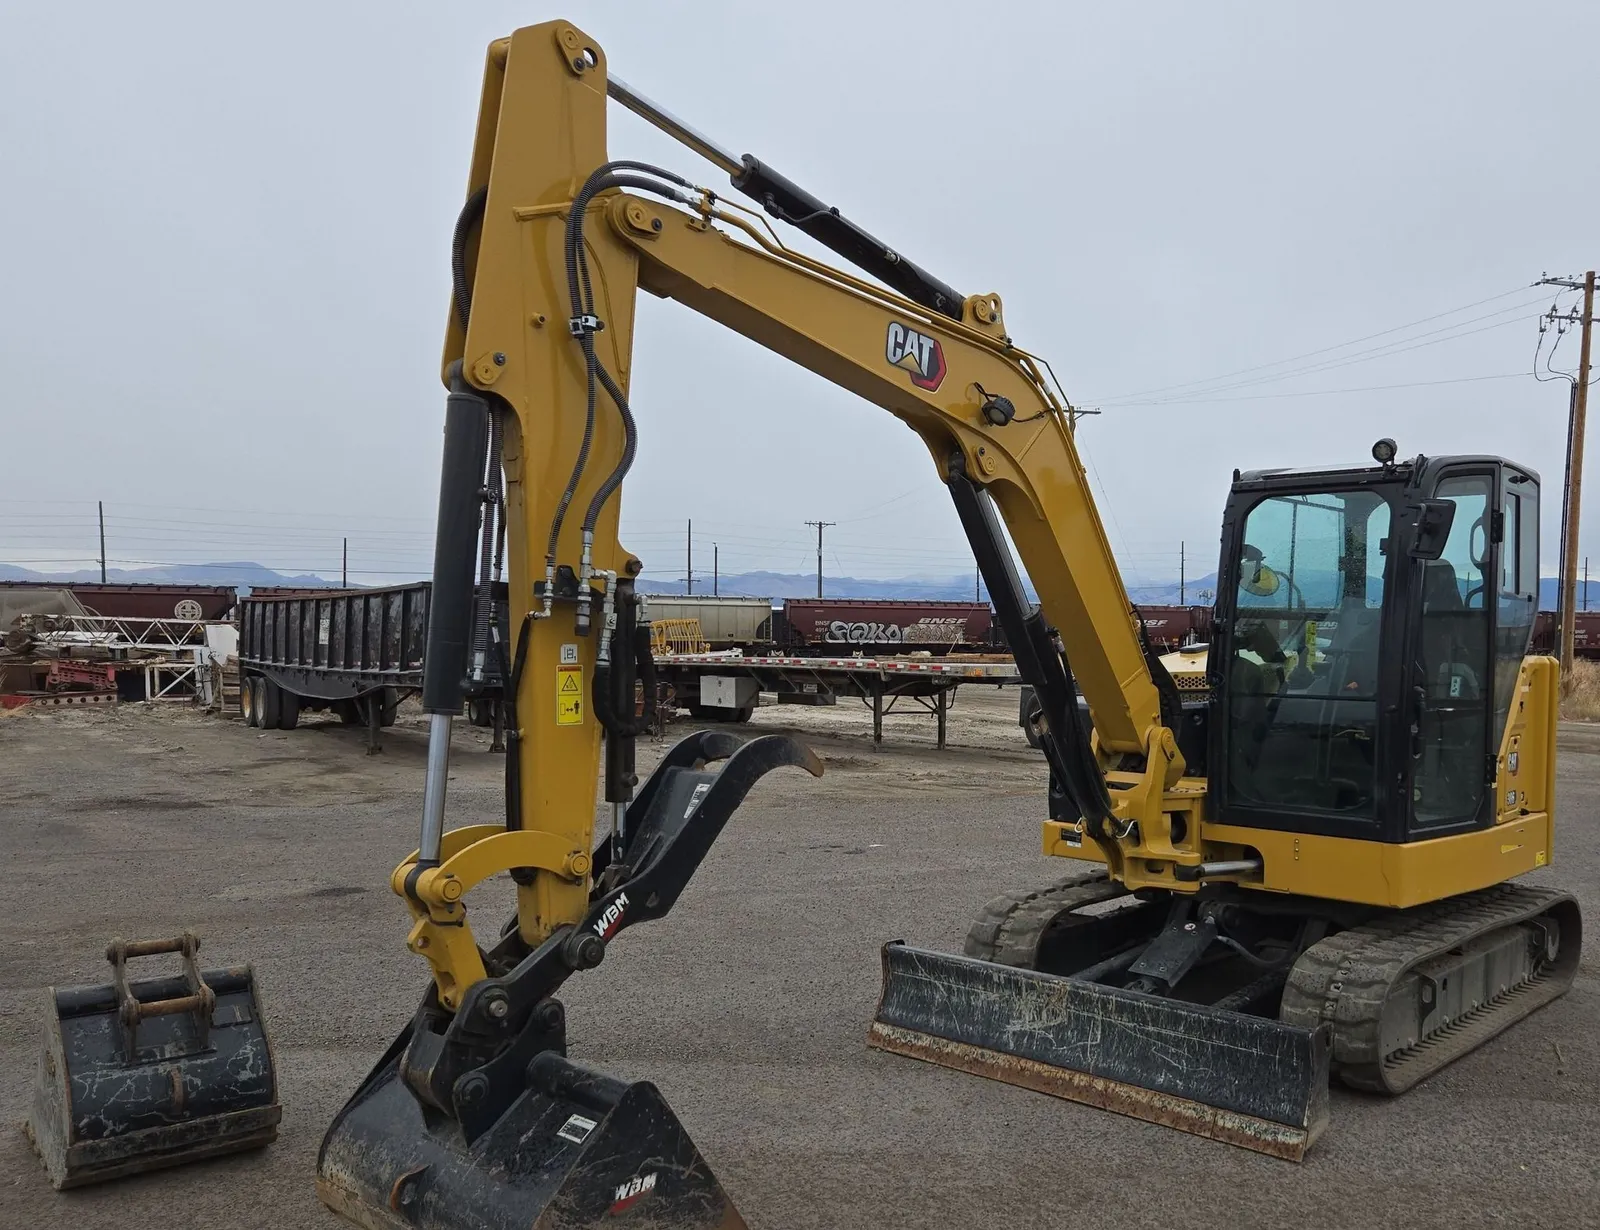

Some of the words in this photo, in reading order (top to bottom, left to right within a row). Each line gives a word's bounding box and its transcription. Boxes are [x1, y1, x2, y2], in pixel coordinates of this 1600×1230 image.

[887, 322, 934, 376] CAT
[592, 892, 630, 937] WBM
[614, 1172, 658, 1200] WBM
